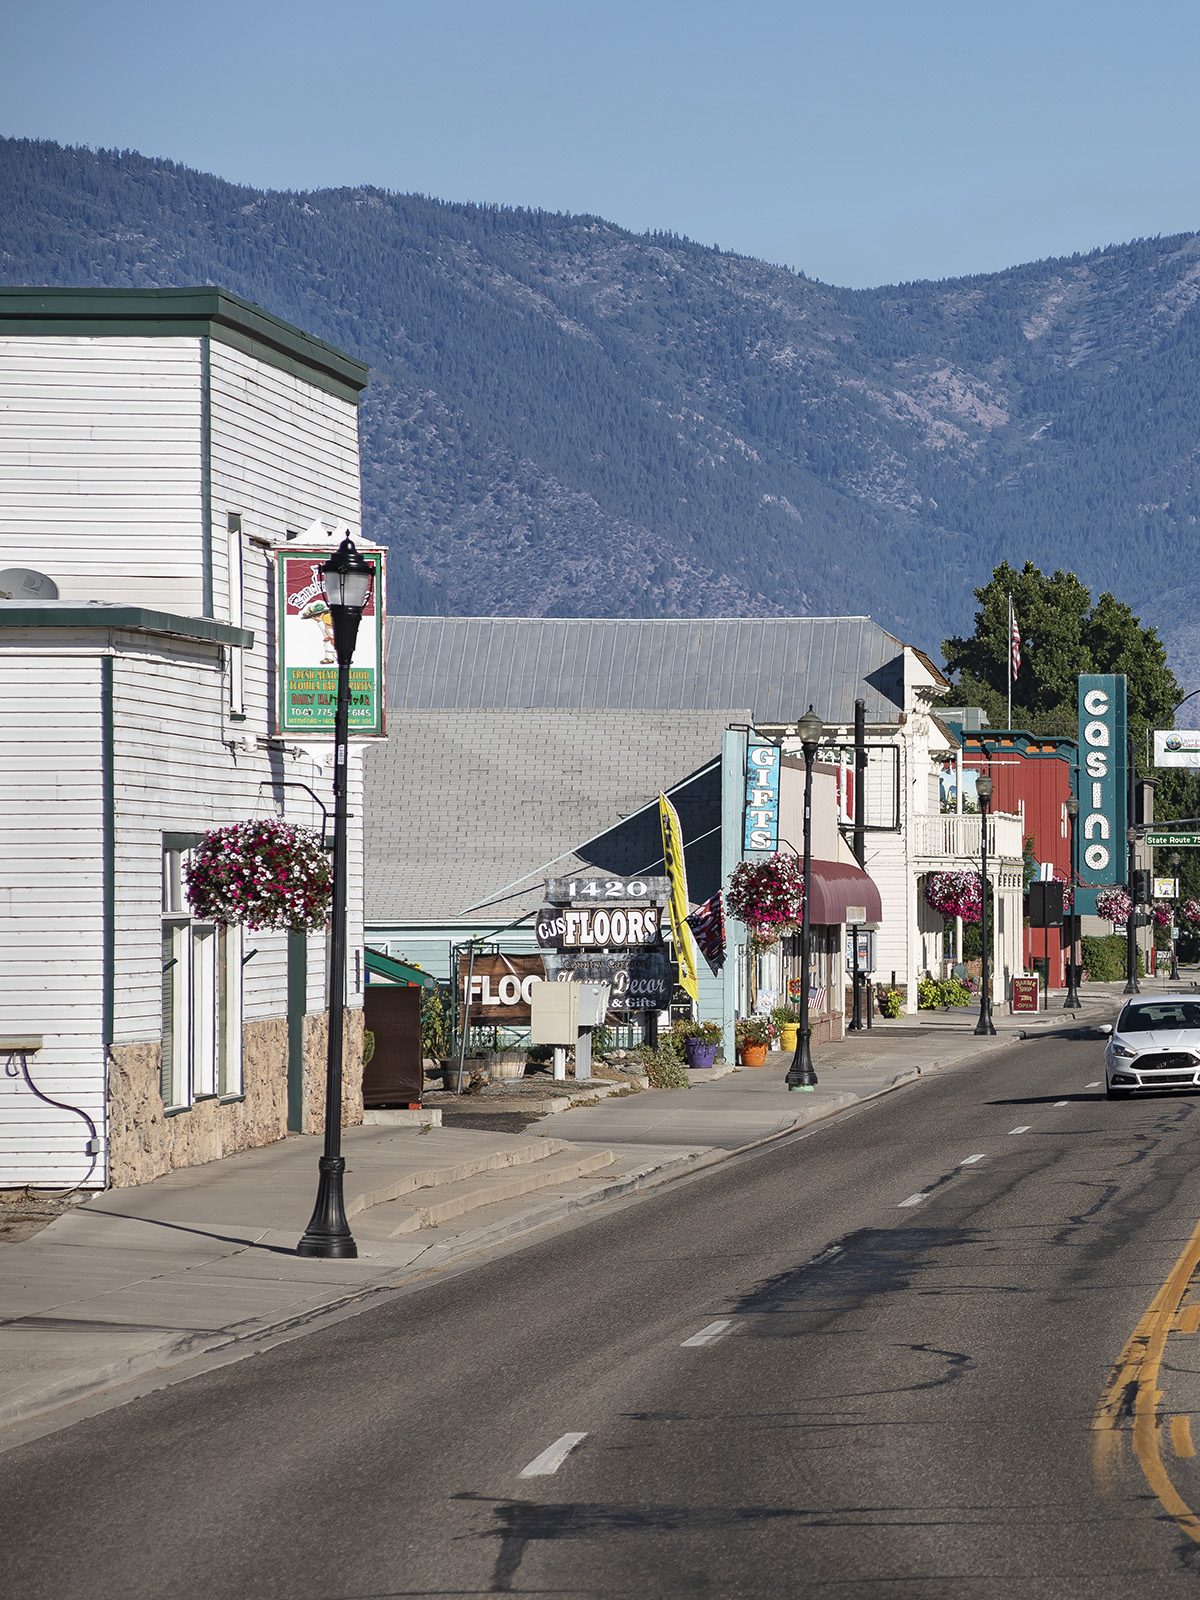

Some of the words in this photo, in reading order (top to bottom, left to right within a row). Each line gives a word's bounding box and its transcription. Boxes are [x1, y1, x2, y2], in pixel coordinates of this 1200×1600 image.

[292, 669, 314, 680] FRESH
[316, 669, 339, 681] MEXIC
[349, 670, 369, 680] FOOD
[289, 681, 320, 691] TEQUILA
[322, 681, 336, 691] BAR
[349, 681, 372, 692] PIRITS
[291, 694, 315, 705] DAILY
[749, 746, 777, 850] GIFTS
[1147, 836, 1167, 844] State
[1169, 836, 1191, 844] Route
[568, 881, 648, 897] 1420
[538, 917, 566, 940] CJS
[564, 909, 657, 945] FLOORS
[464, 974, 543, 1005] FLOO
[613, 970, 666, 995] Decor
[611, 998, 623, 1008] &
[625, 997, 657, 1008] Gifts
